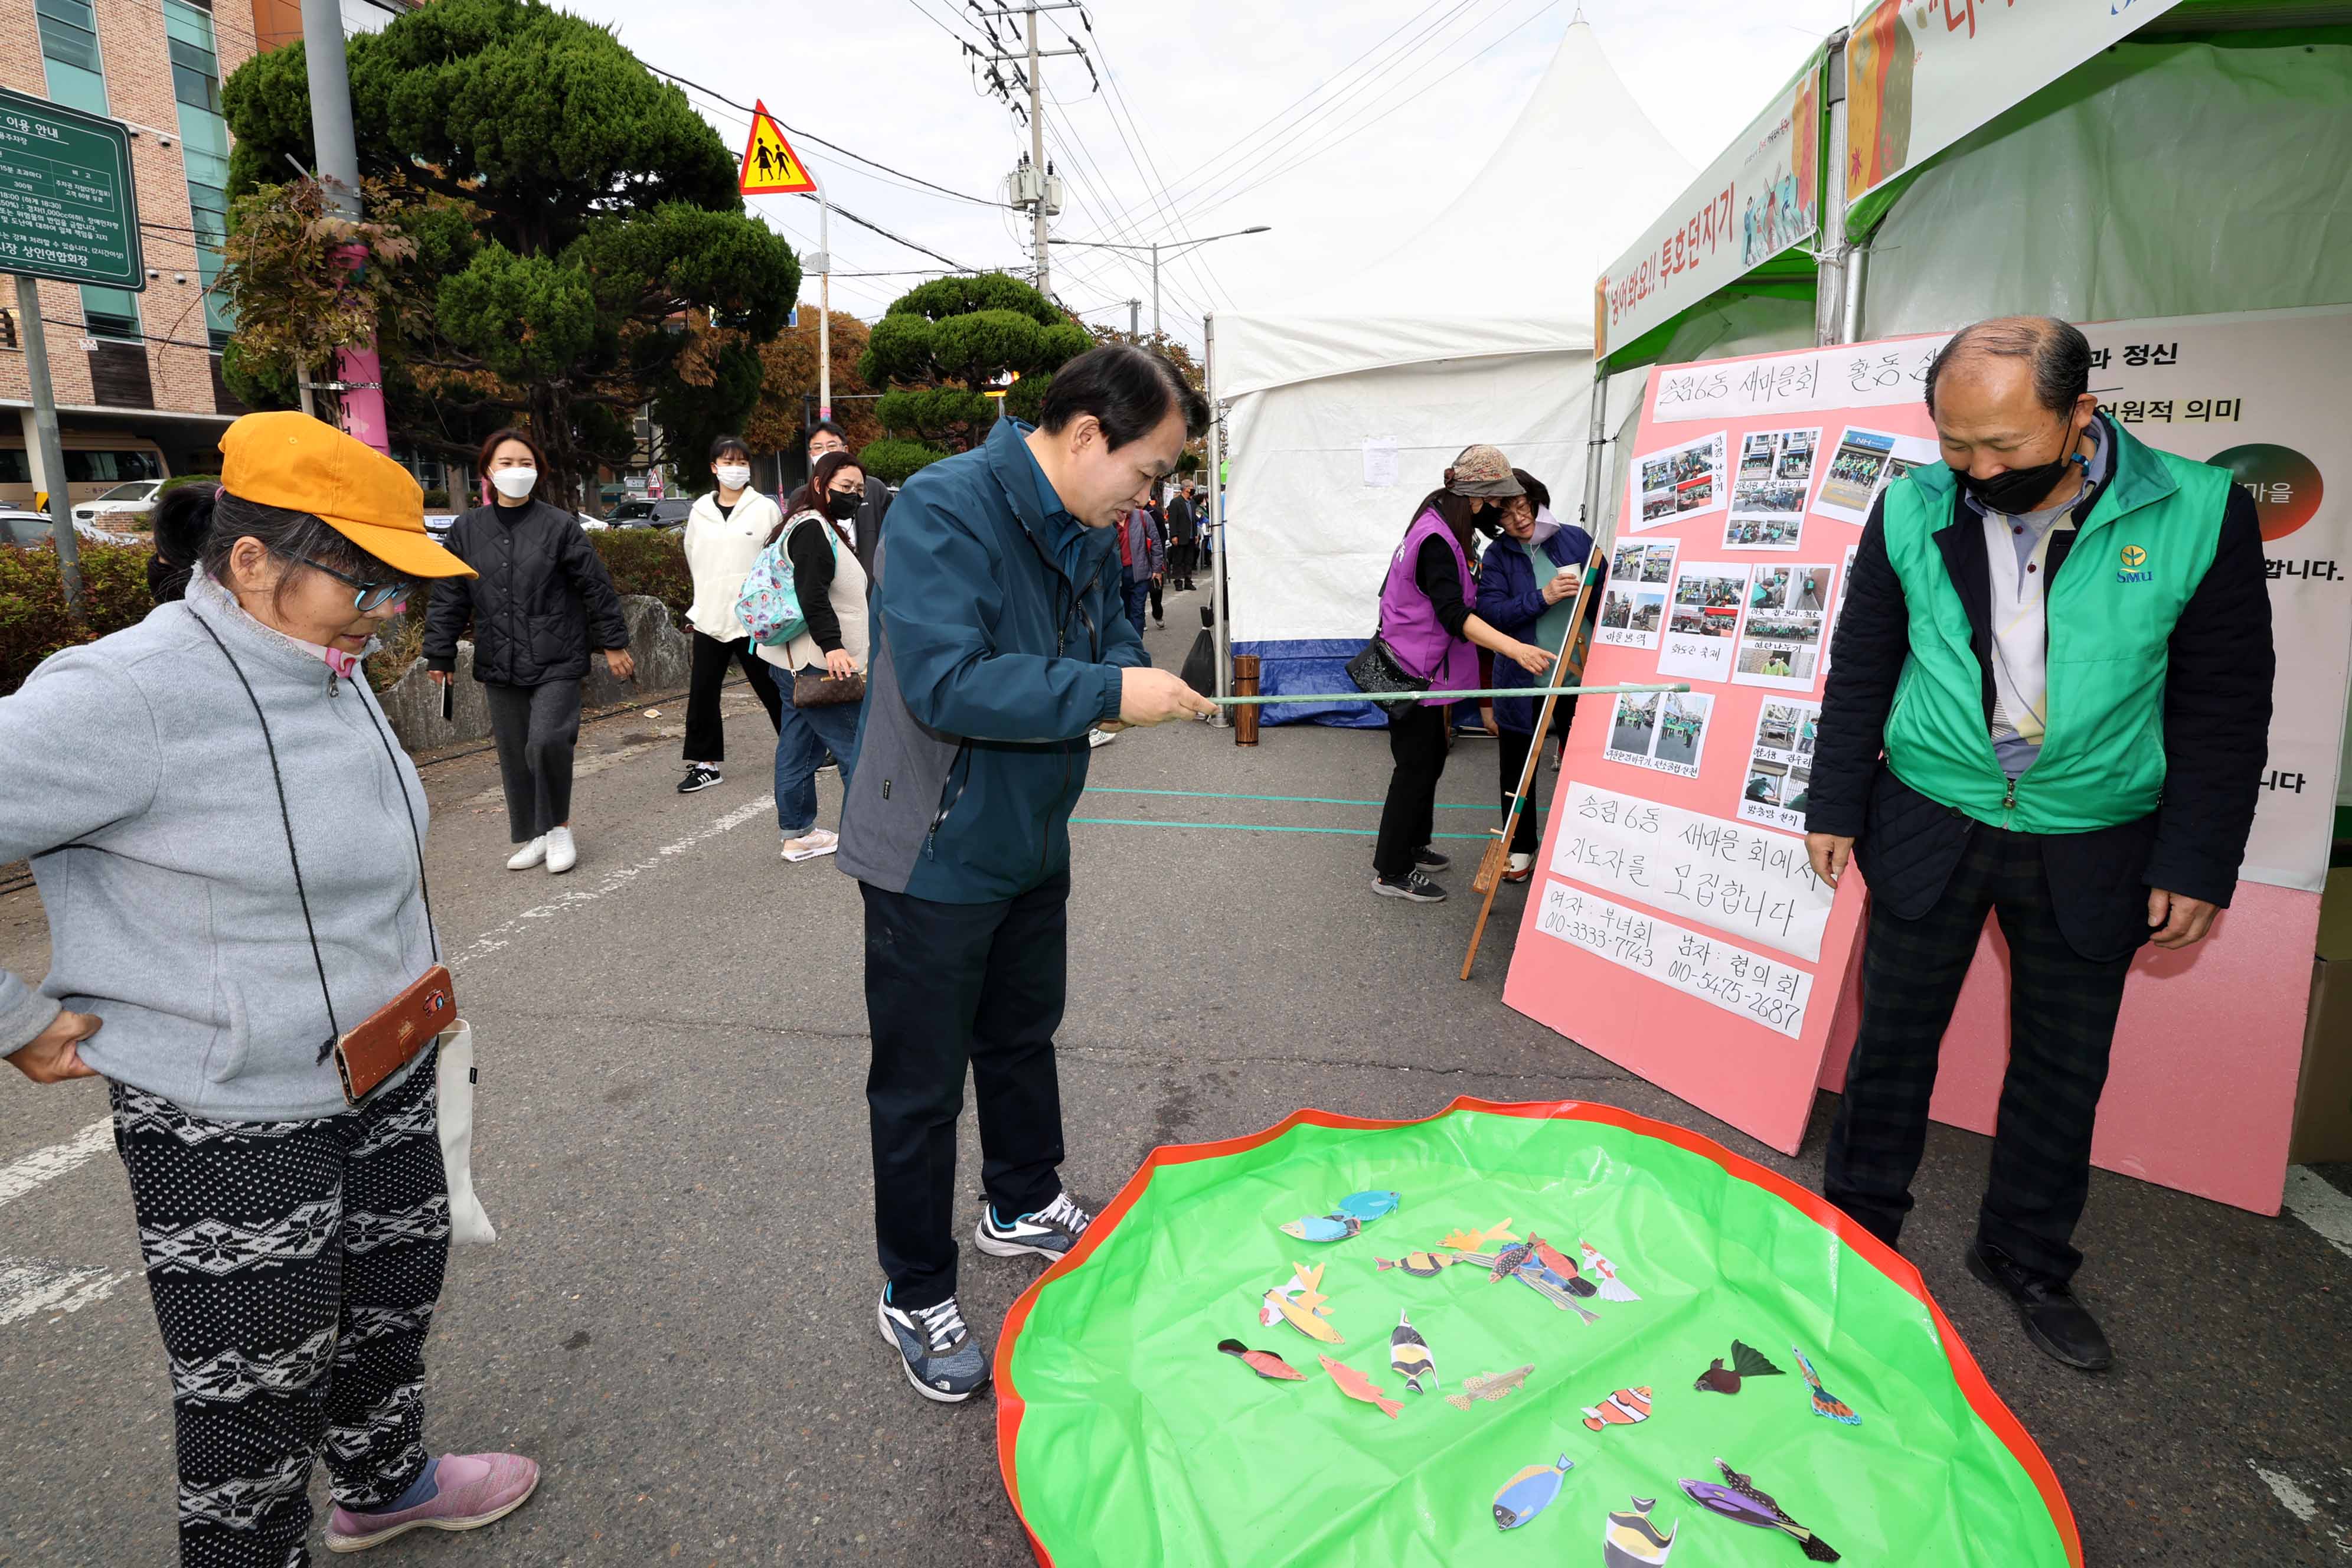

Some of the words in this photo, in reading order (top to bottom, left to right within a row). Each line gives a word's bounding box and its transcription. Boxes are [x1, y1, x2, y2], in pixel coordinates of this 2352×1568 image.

[6, 117, 30, 132] 이용
[35, 123, 58, 138] 안내
[14, 181, 32, 192] 300원
[0, 191, 19, 201] 18:00
[41, 200, 61, 210] 18:30)
[35, 222, 56, 231] 대하여
[1660, 179, 1735, 289] 투호던지기
[22, 245, 88, 266] 상인연합회장
[2123, 342, 2178, 367] 정신
[1739, 359, 1819, 402] 새마을회
[1847, 353, 1900, 393] 활동
[2184, 398, 2242, 423] 의미
[1856, 437, 1872, 446] NH
[2237, 482, 2294, 503] 마을
[2116, 571, 2154, 584] SMU
[1779, 812, 1798, 827] 설치
[1564, 838, 1649, 887] 지도자를
[1664, 864, 1795, 937] 모집합니다
[1600, 907, 1652, 948] 부녀회
[1730, 955, 1799, 1001] 협의회
[1545, 911, 1654, 968] 010-3333-7743
[1668, 961, 1801, 1030] 010-5475-2687
